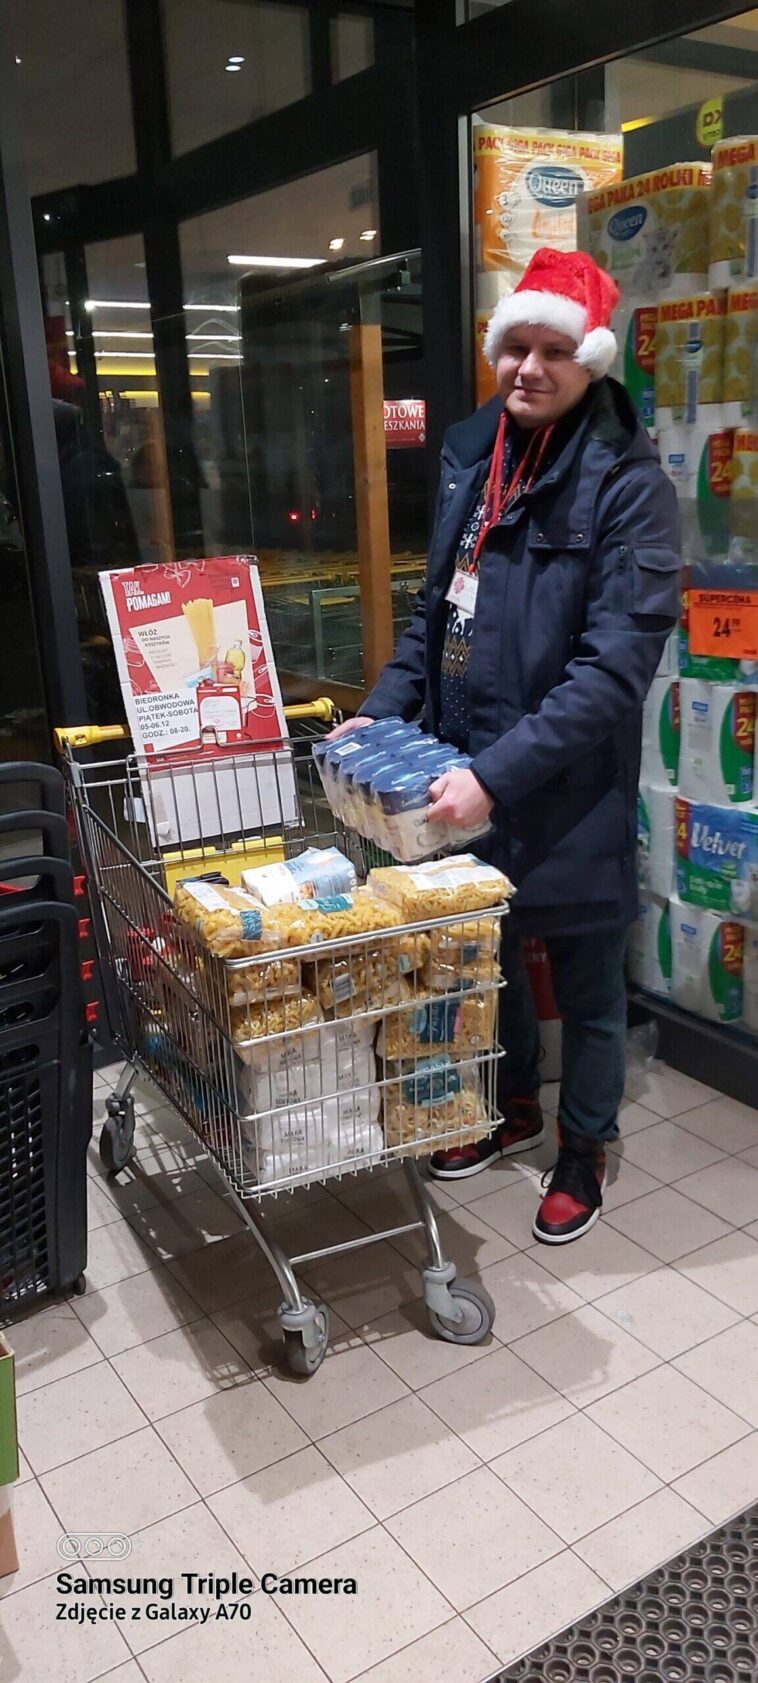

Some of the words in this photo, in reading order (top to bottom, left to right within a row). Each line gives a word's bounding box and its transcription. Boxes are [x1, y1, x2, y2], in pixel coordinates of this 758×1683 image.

[718, 143, 756, 167] MEGA
[528, 172, 578, 196] Queen
[607, 184, 635, 207] PAKA
[636, 178, 651, 197] 24
[652, 168, 693, 193] ROLKI
[608, 211, 645, 234] Queen
[660, 301, 694, 322] MEGA
[698, 593, 752, 604] SUPERCENA
[712, 616, 731, 638] 24
[135, 693, 180, 705] BIEDRONKA
[136, 699, 195, 713] UL.OBWODOWA
[138, 707, 199, 722] PIĄTEK-SOBOTA
[140, 720, 170, 731] 05-06.12
[691, 821, 747, 859] Velvet
